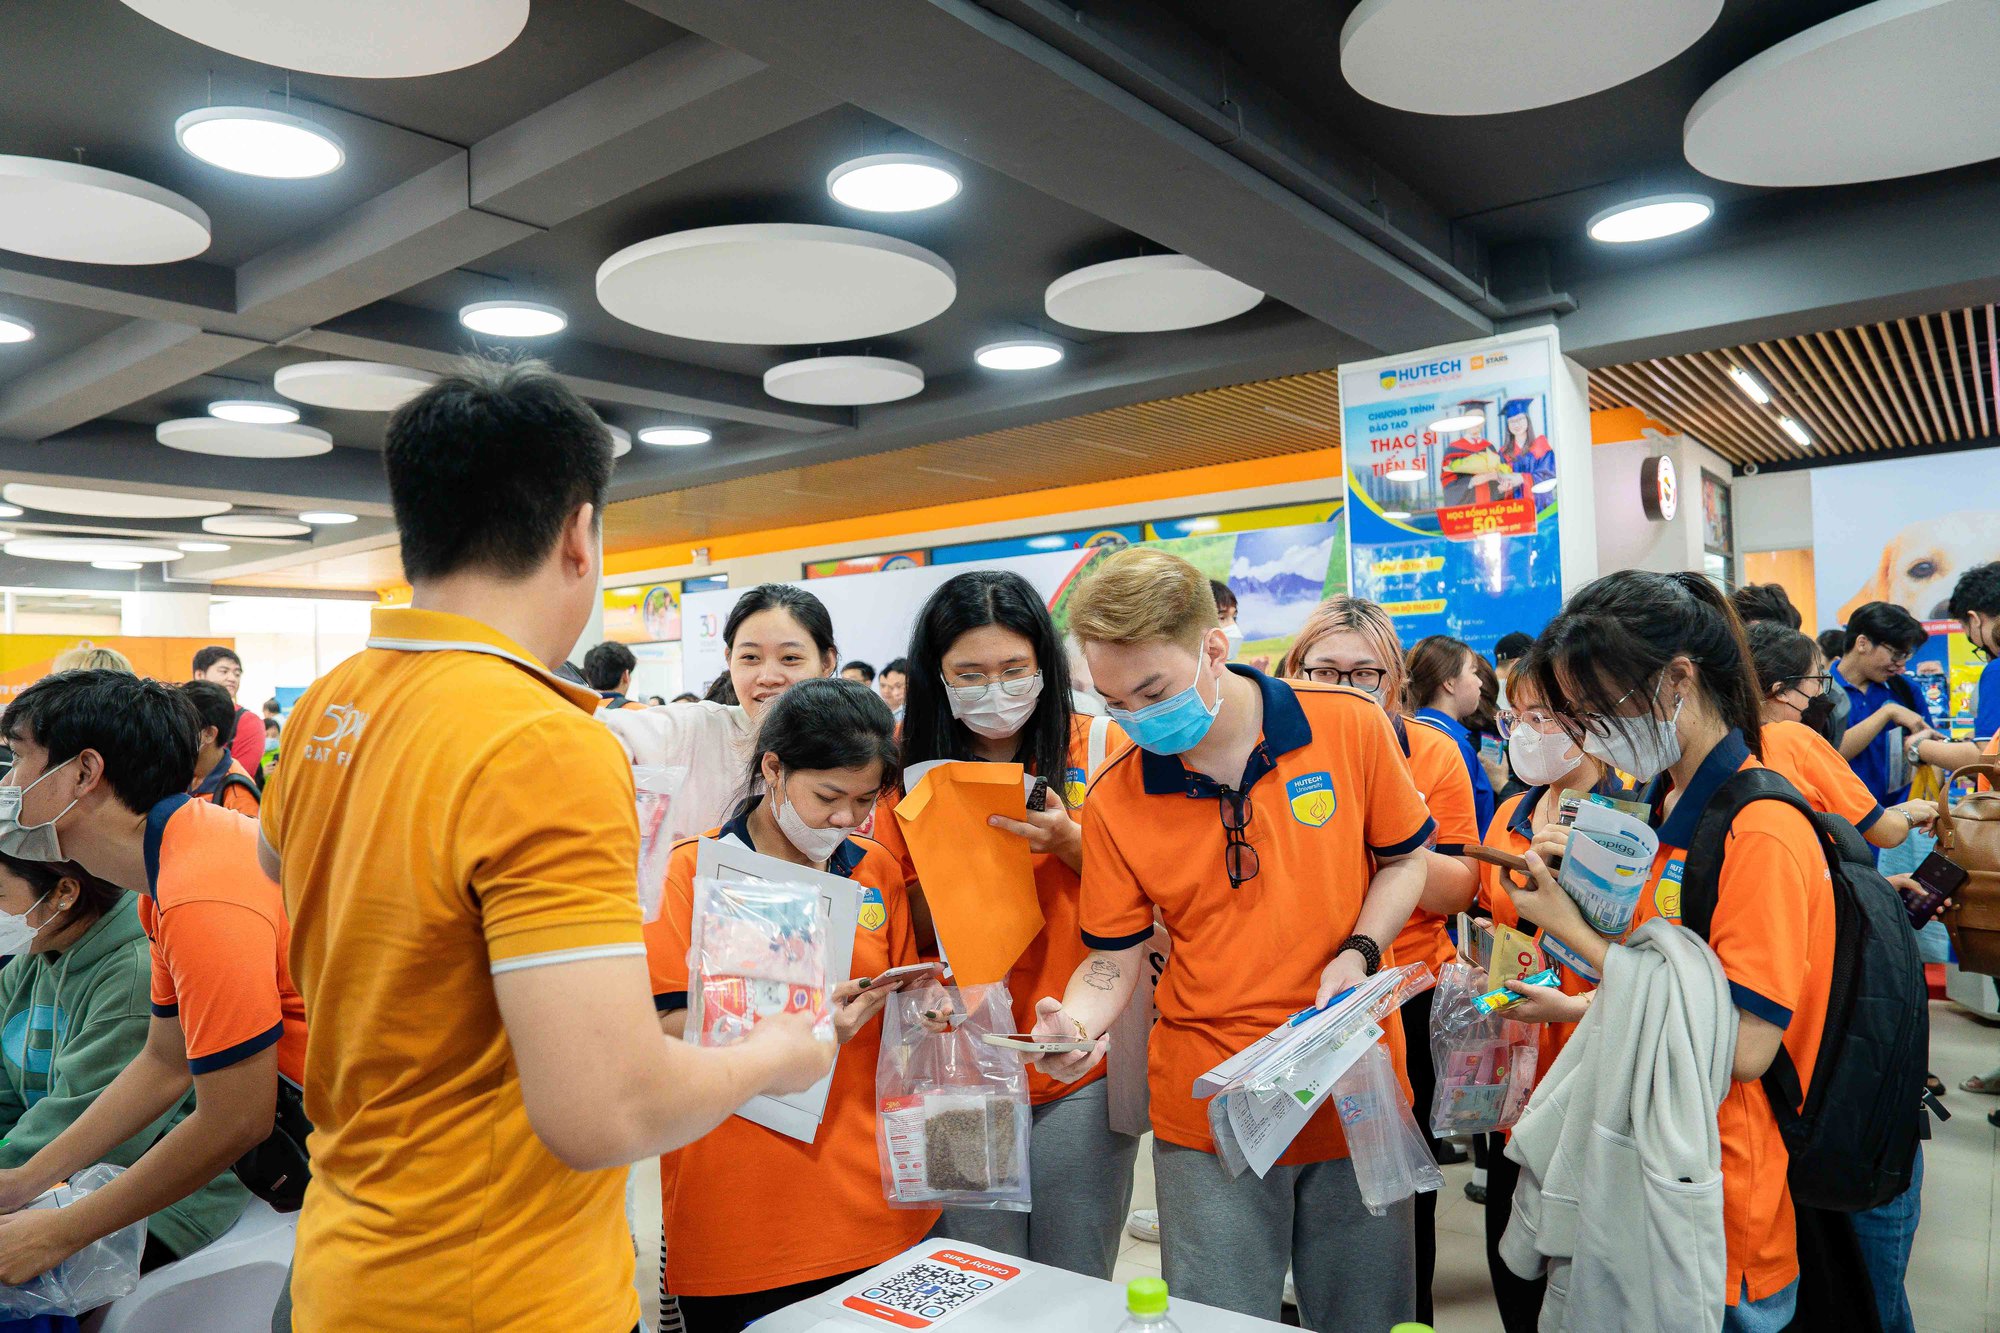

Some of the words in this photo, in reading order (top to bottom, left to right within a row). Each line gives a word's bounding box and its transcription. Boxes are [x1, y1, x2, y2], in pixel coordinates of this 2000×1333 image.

[1486, 354, 1508, 364] STARS
[1398, 359, 1461, 381] HUTECH
[1370, 434, 1417, 454] THẠC
[1294, 775, 1323, 788] HUTECH
[1295, 782, 1323, 793] University
[1592, 838, 1636, 857] opigg
[942, 1252, 970, 1265] Fans
[968, 1260, 1009, 1275] Catchy
